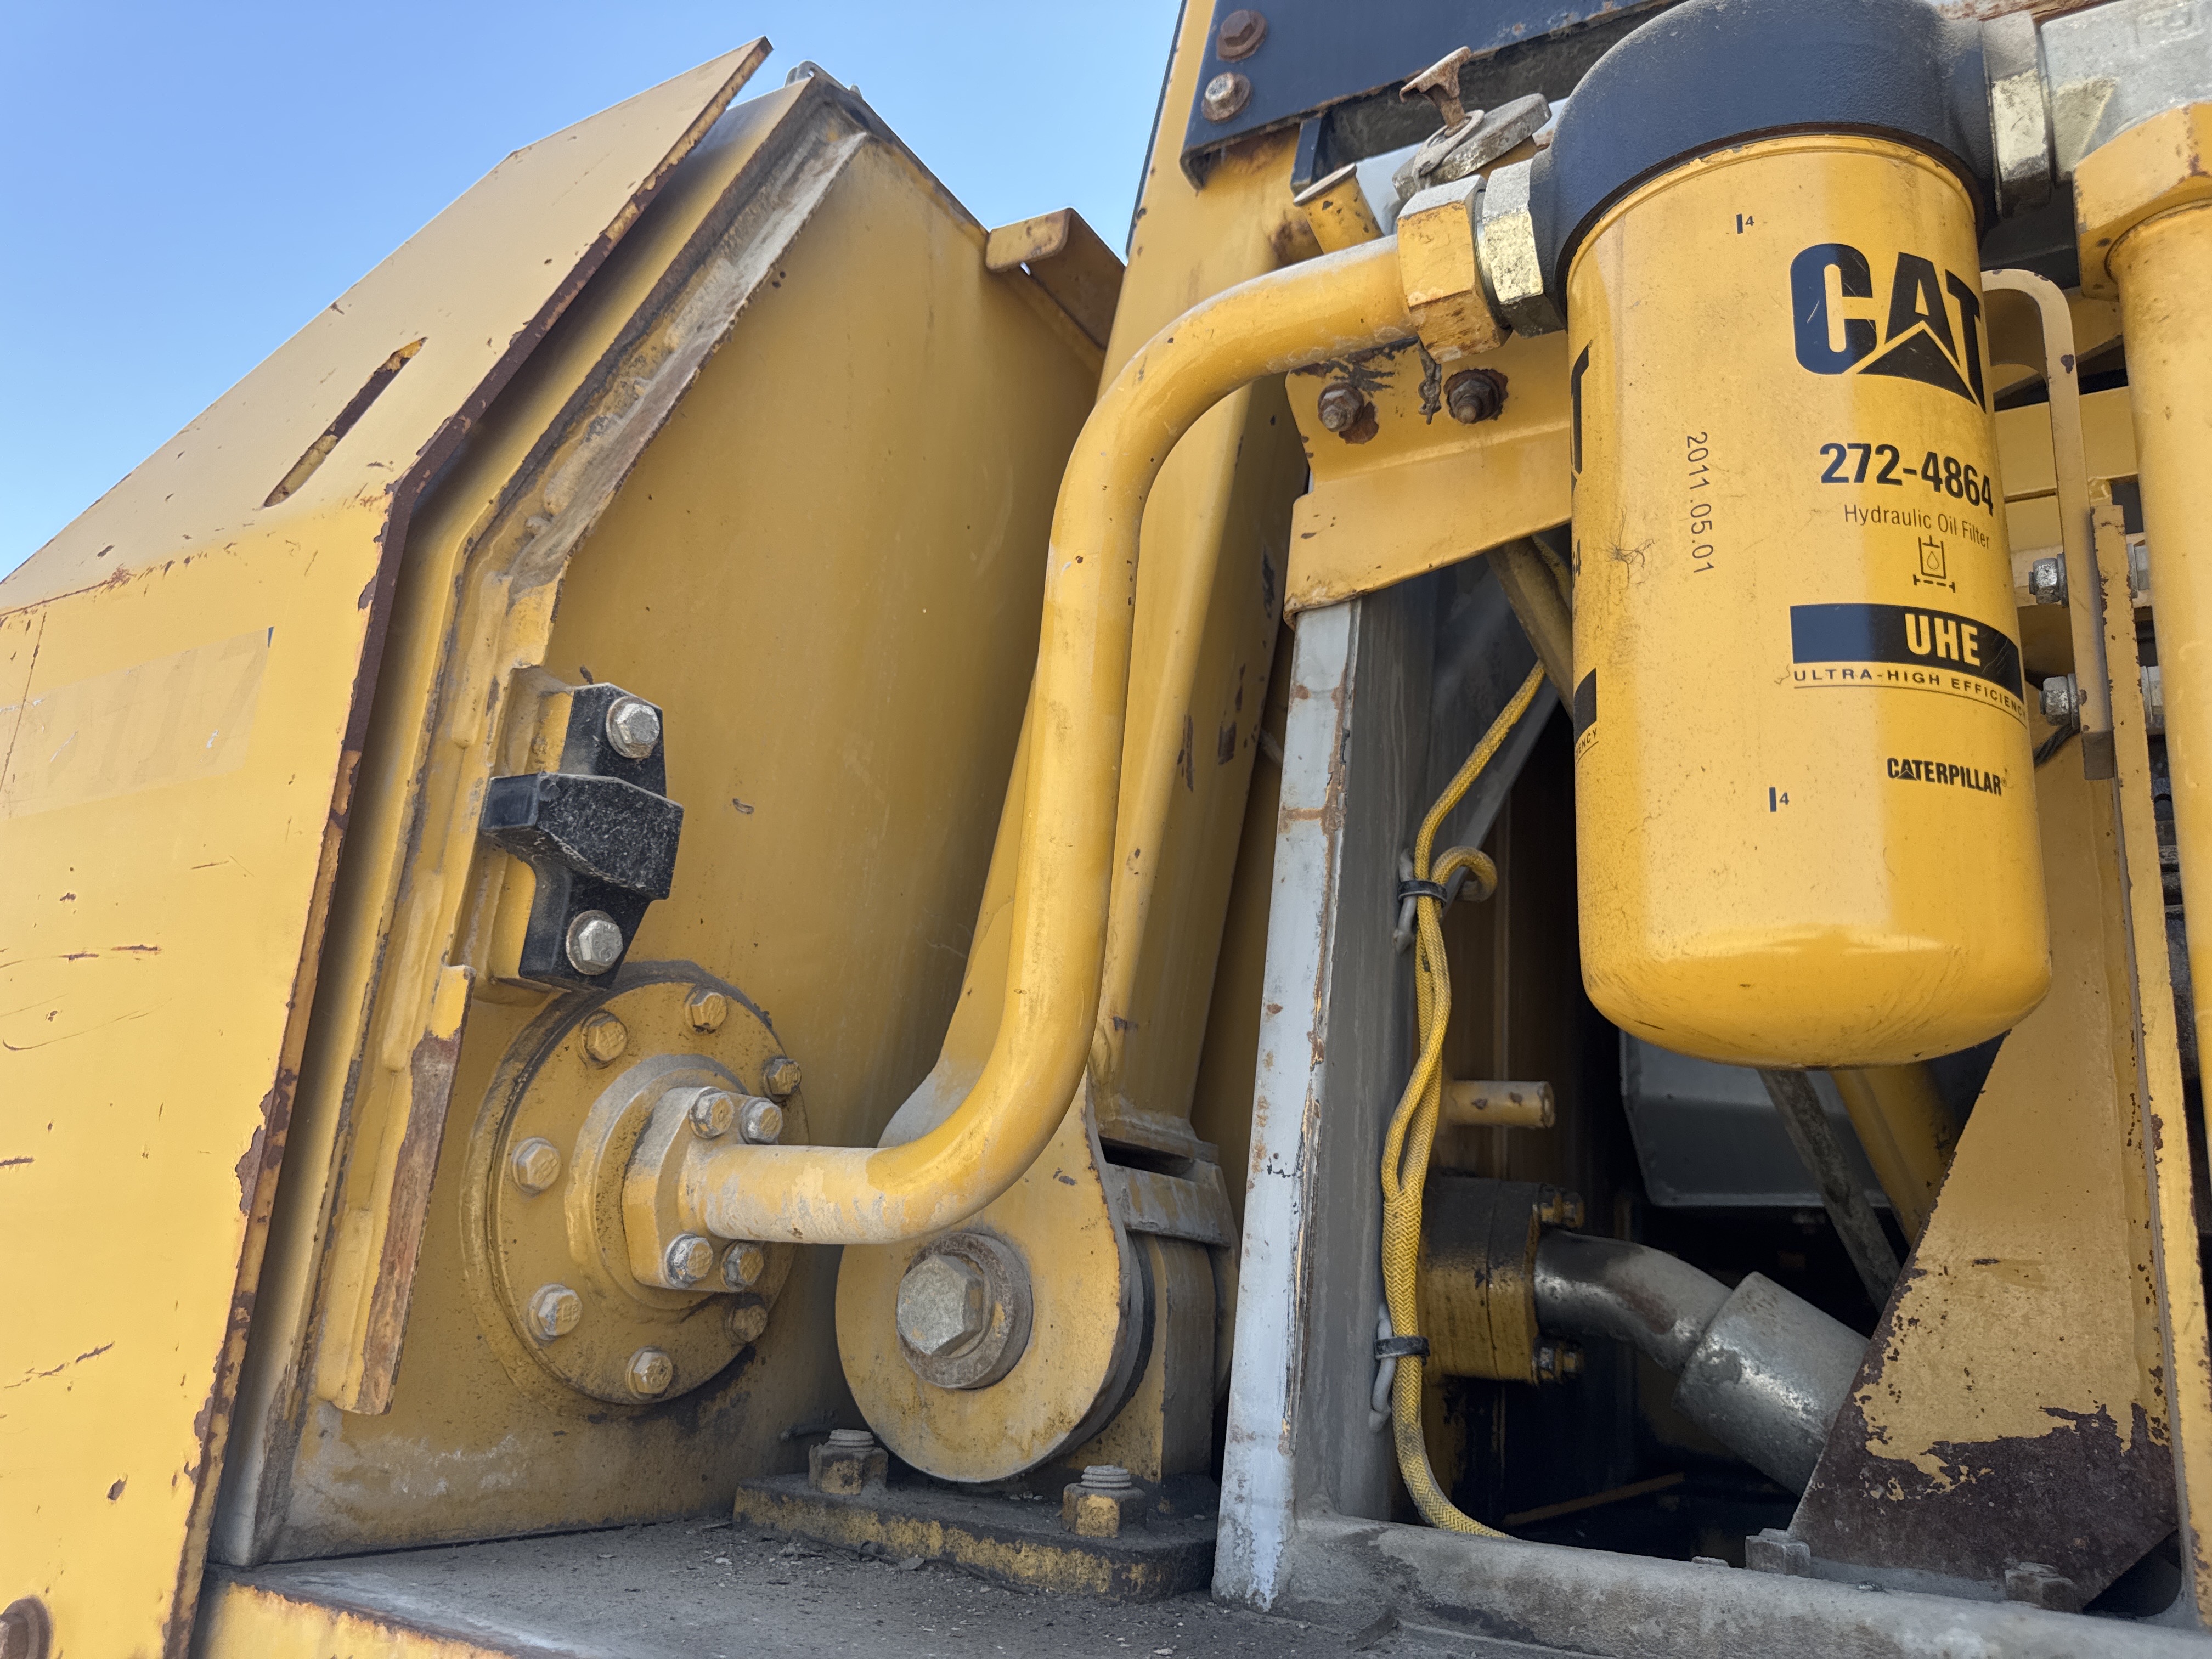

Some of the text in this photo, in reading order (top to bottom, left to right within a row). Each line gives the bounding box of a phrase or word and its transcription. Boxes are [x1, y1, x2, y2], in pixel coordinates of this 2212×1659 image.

[1790, 242, 1987, 415] CAT
[1686, 431, 1714, 573] 2011.05.01
[1819, 442, 1994, 517] 272-4864
[1844, 504, 1990, 550] Hydraulic Oil Filter
[1904, 613, 1981, 667] UHE
[1793, 668, 1940, 686] ULTRA-HIGH
